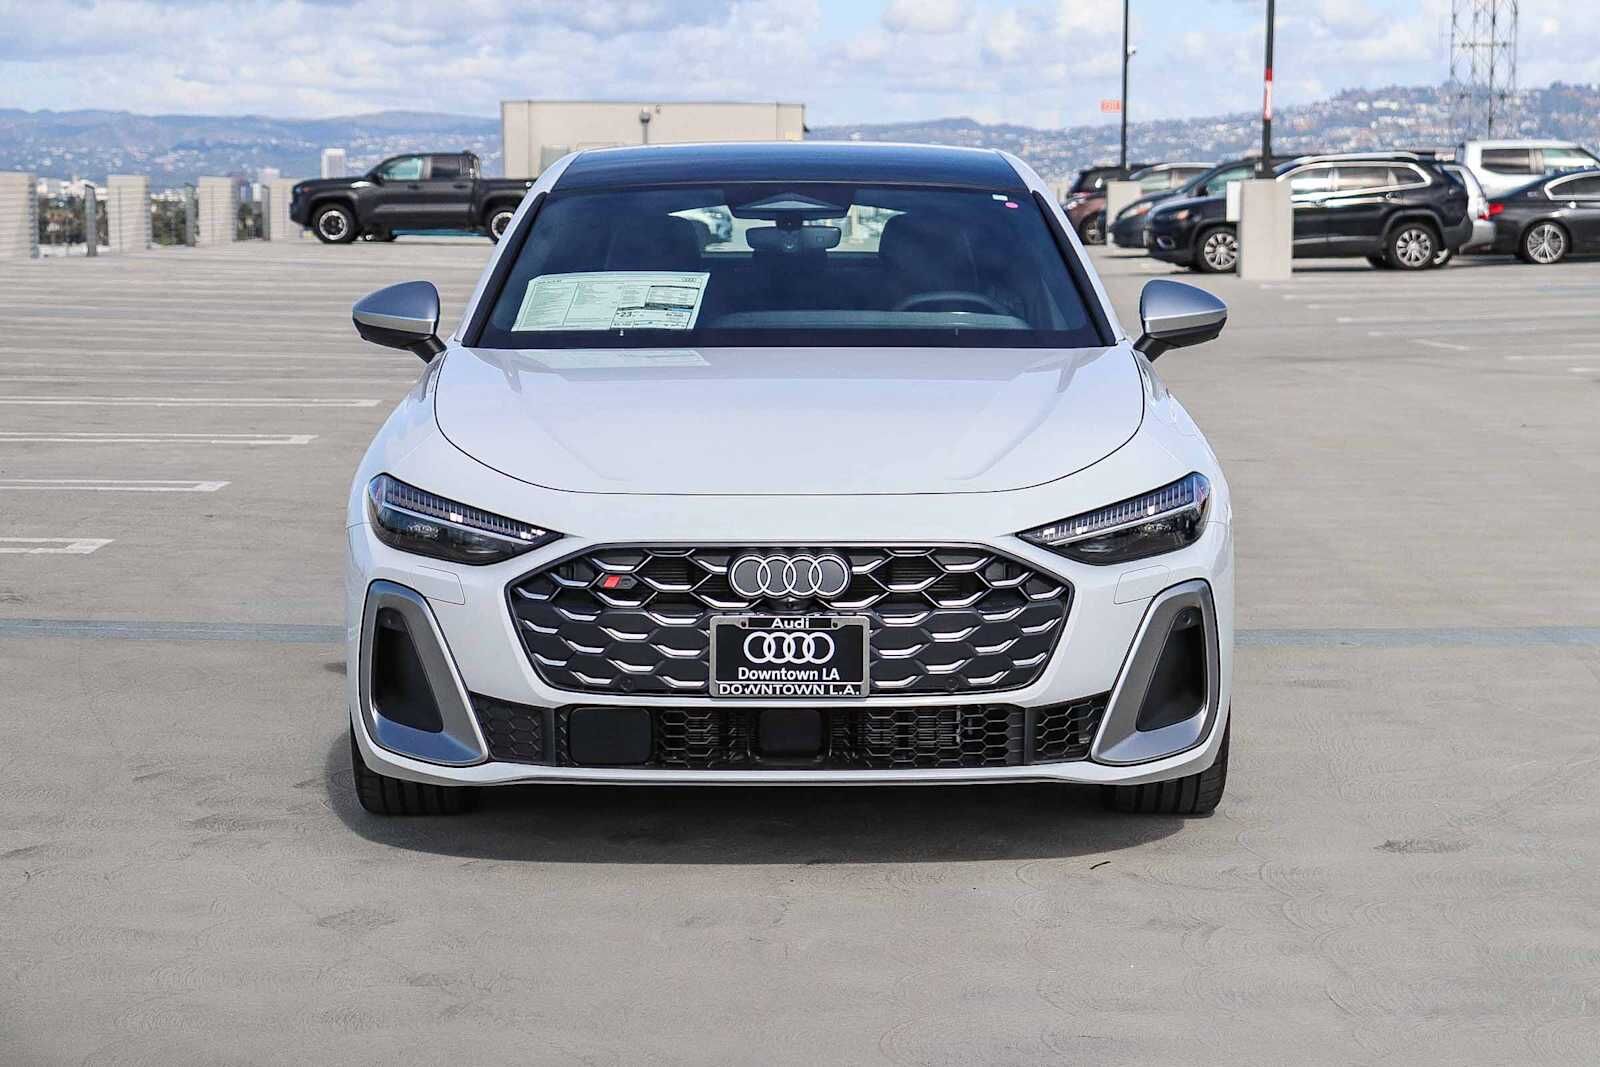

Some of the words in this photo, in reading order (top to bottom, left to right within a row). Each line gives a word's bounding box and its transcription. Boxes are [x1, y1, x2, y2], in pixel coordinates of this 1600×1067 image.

[771, 617, 810, 629] Audi
[738, 667, 818, 681] Downtown
[822, 668, 840, 680] LA
[719, 684, 825, 695] DOWNTOWN
[829, 684, 860, 695] L.A.
